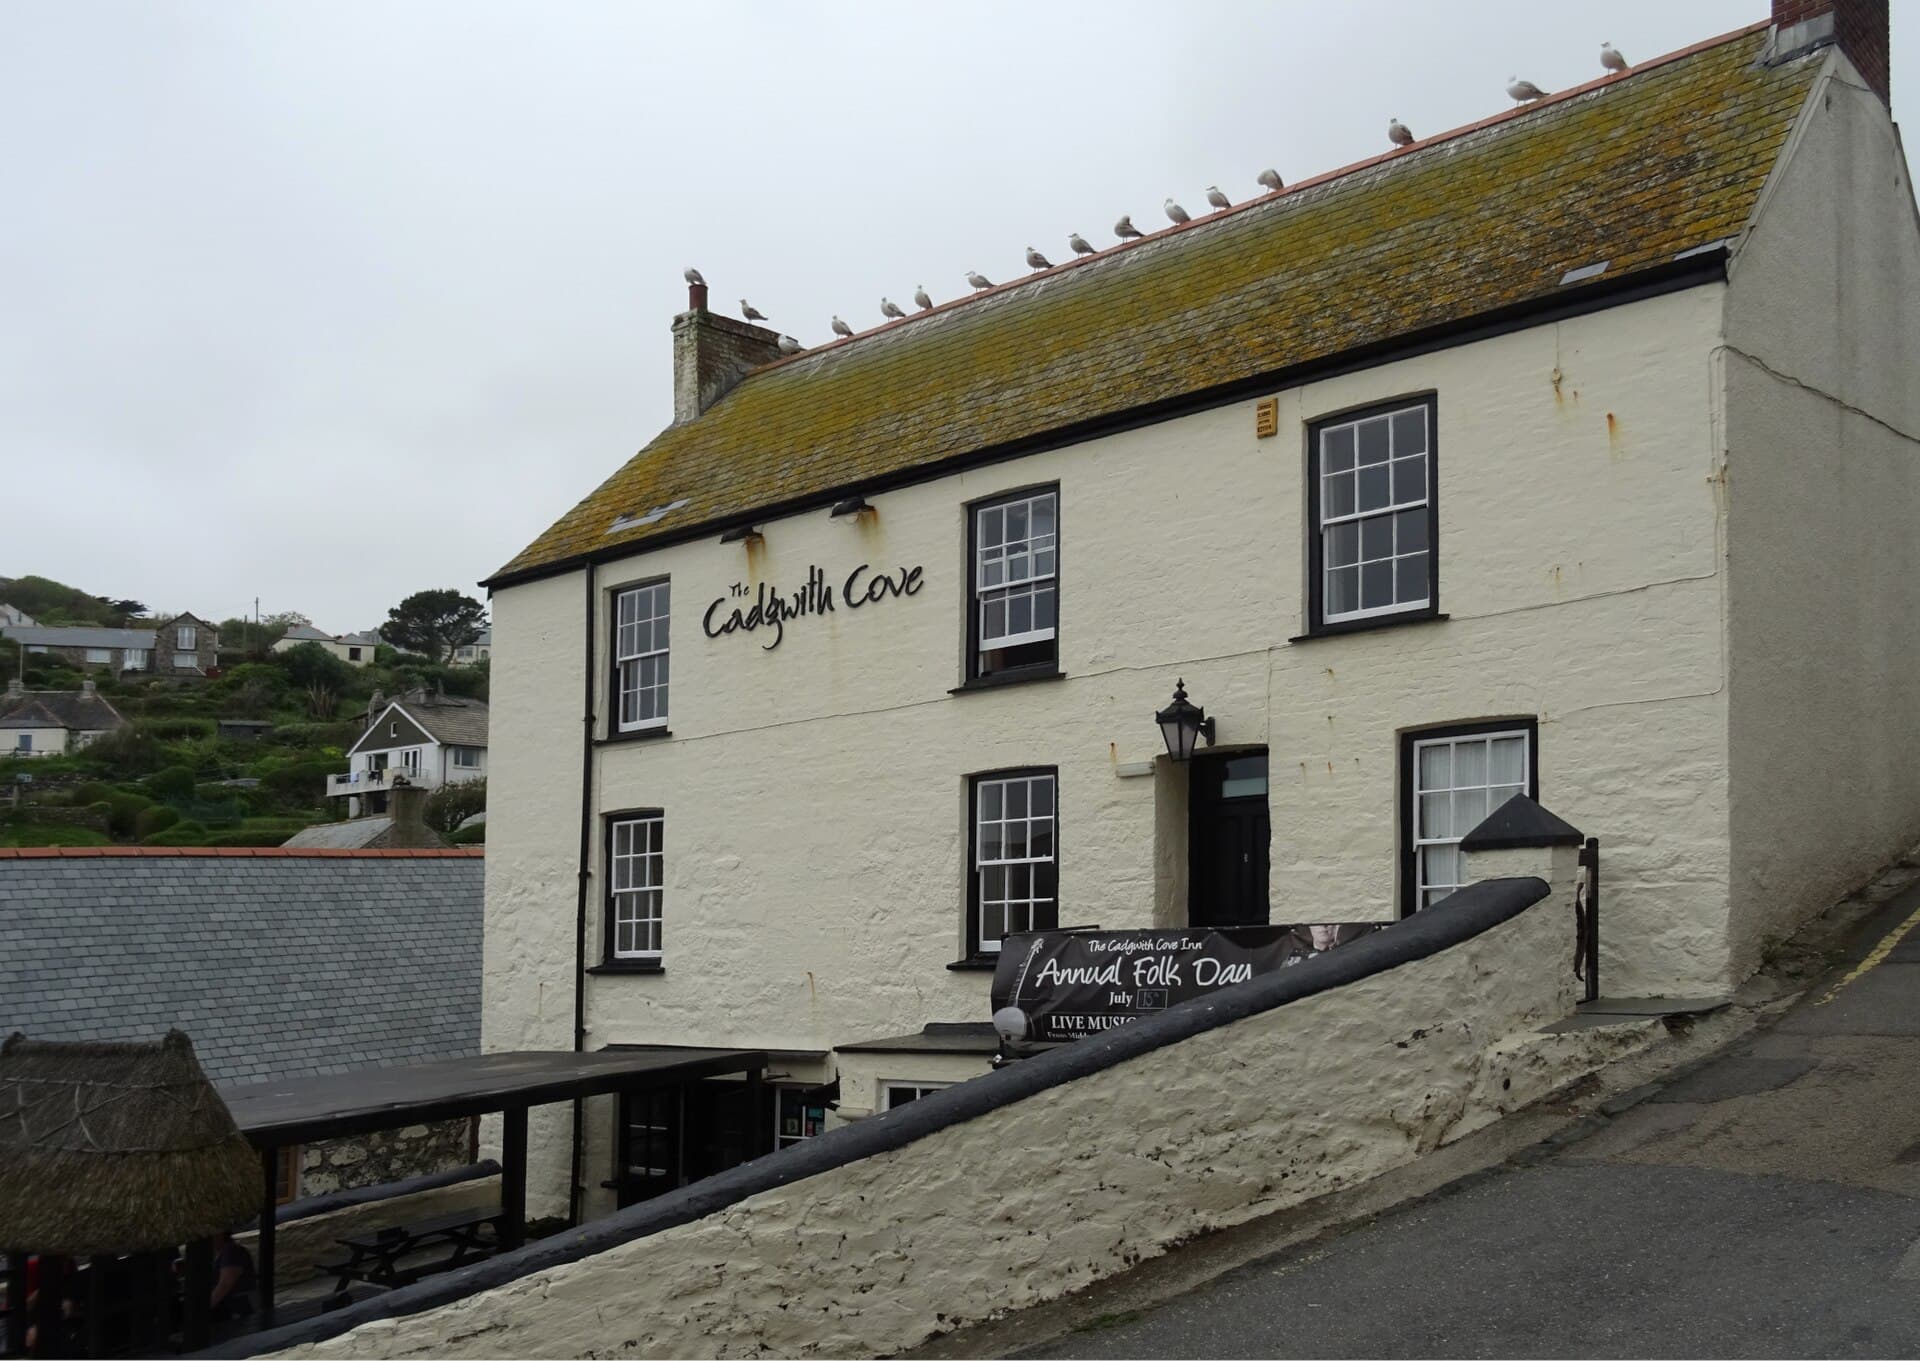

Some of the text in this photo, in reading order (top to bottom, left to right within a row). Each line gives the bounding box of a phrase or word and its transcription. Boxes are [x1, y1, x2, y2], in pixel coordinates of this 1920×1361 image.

[729, 581, 750, 598] The
[702, 564, 925, 651] Cadgwith Cove
[1088, 937, 1203, 956] The Cadgwith Cove Inn
[1035, 956, 1122, 988] Annual
[1133, 955, 1182, 987] Folk
[1109, 991, 1133, 1008] July
[1051, 1015, 1086, 1029] LIVE
